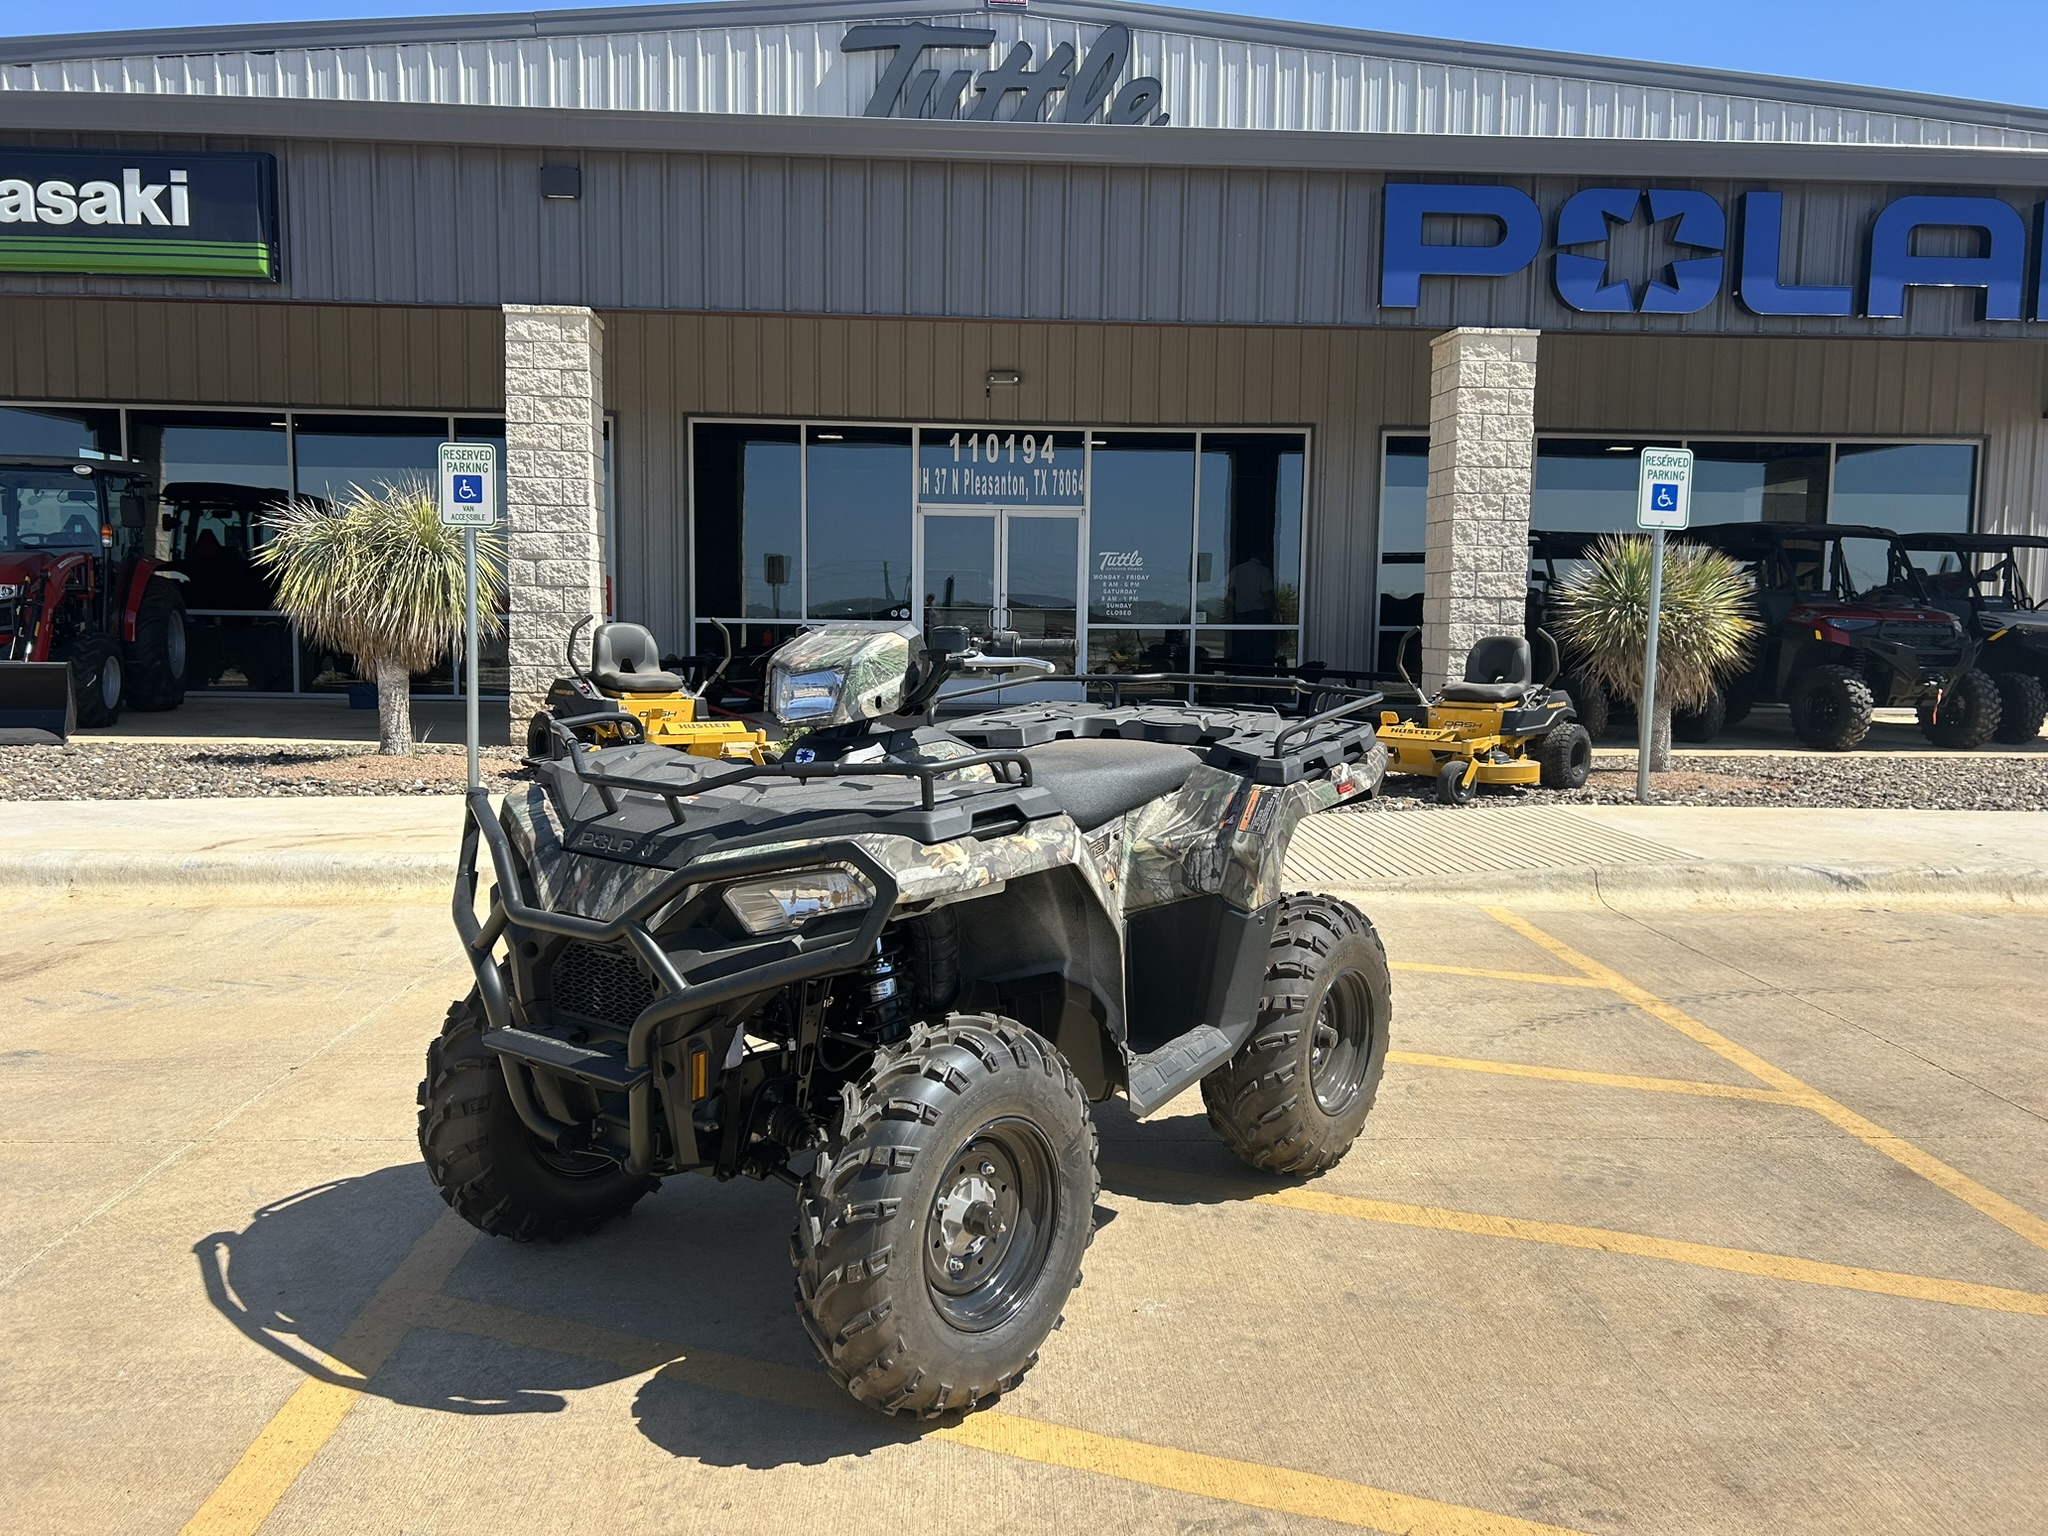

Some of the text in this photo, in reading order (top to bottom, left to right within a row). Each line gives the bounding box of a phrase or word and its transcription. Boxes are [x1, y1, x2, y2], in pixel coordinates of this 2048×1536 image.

[840, 21, 1171, 127] Tuttle
[1376, 182, 2048, 322] POLA
[949, 432, 1055, 464] 110194
[443, 449, 491, 461] RESERVED
[446, 461, 489, 473] PARKING
[1645, 456, 1689, 468] RESERVED
[1647, 469, 1685, 481] PARKING
[934, 468, 947, 495] 37
[952, 468, 959, 495] N
[964, 468, 1029, 502] Pleasanton,
[1034, 469, 1048, 496] TX
[1052, 468, 1084, 496] 78064
[451, 513, 486, 521] ACCESSIBLE
[1099, 549, 1144, 571] Tuttle
[638, 710, 677, 719] DSH
[677, 721, 732, 729] HUSTLER
[1443, 720, 1483, 729] DASH
[1390, 727, 1442, 736] HUSTLER
